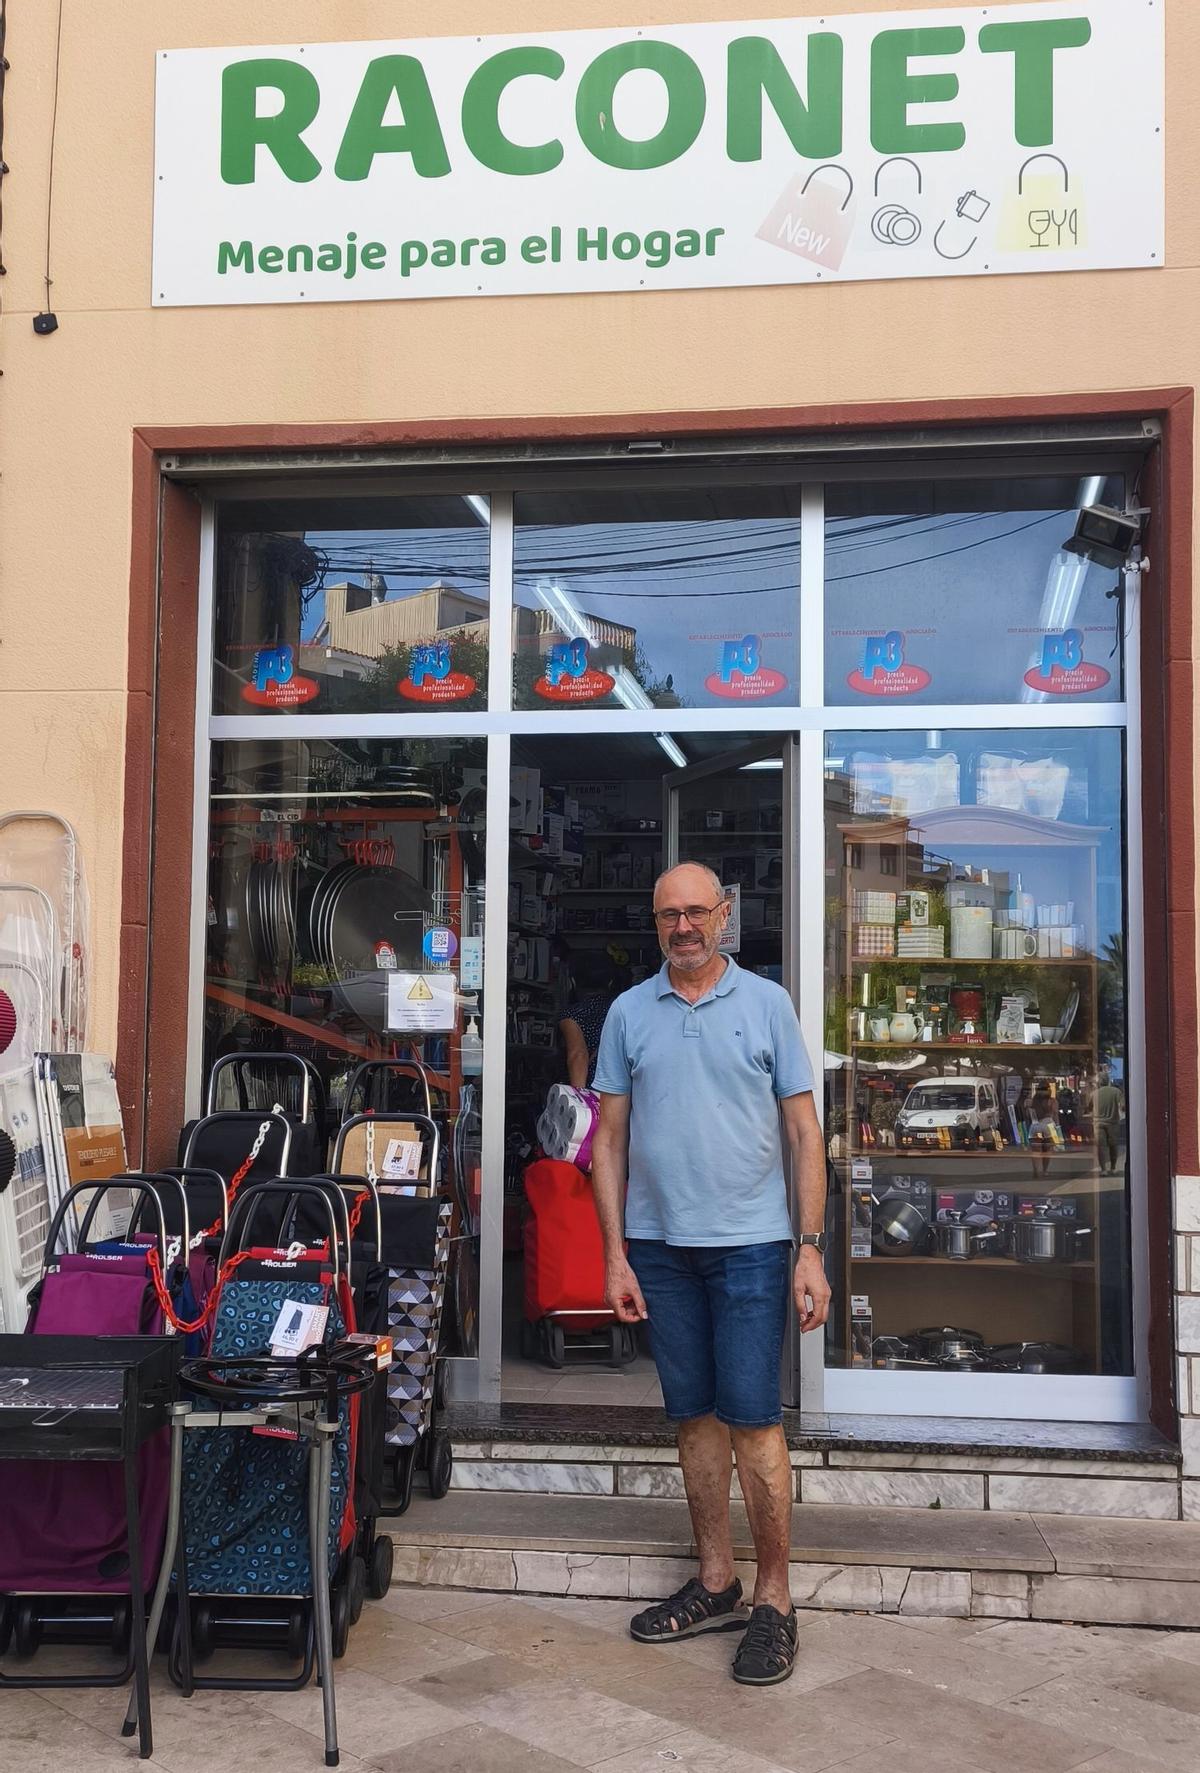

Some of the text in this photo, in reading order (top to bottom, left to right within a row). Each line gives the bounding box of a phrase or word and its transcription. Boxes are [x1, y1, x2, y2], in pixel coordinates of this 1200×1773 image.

[221, 19, 1090, 185] RACONET
[218, 228, 723, 279] Menaje para el Hogar
[777, 215, 831, 257] New
